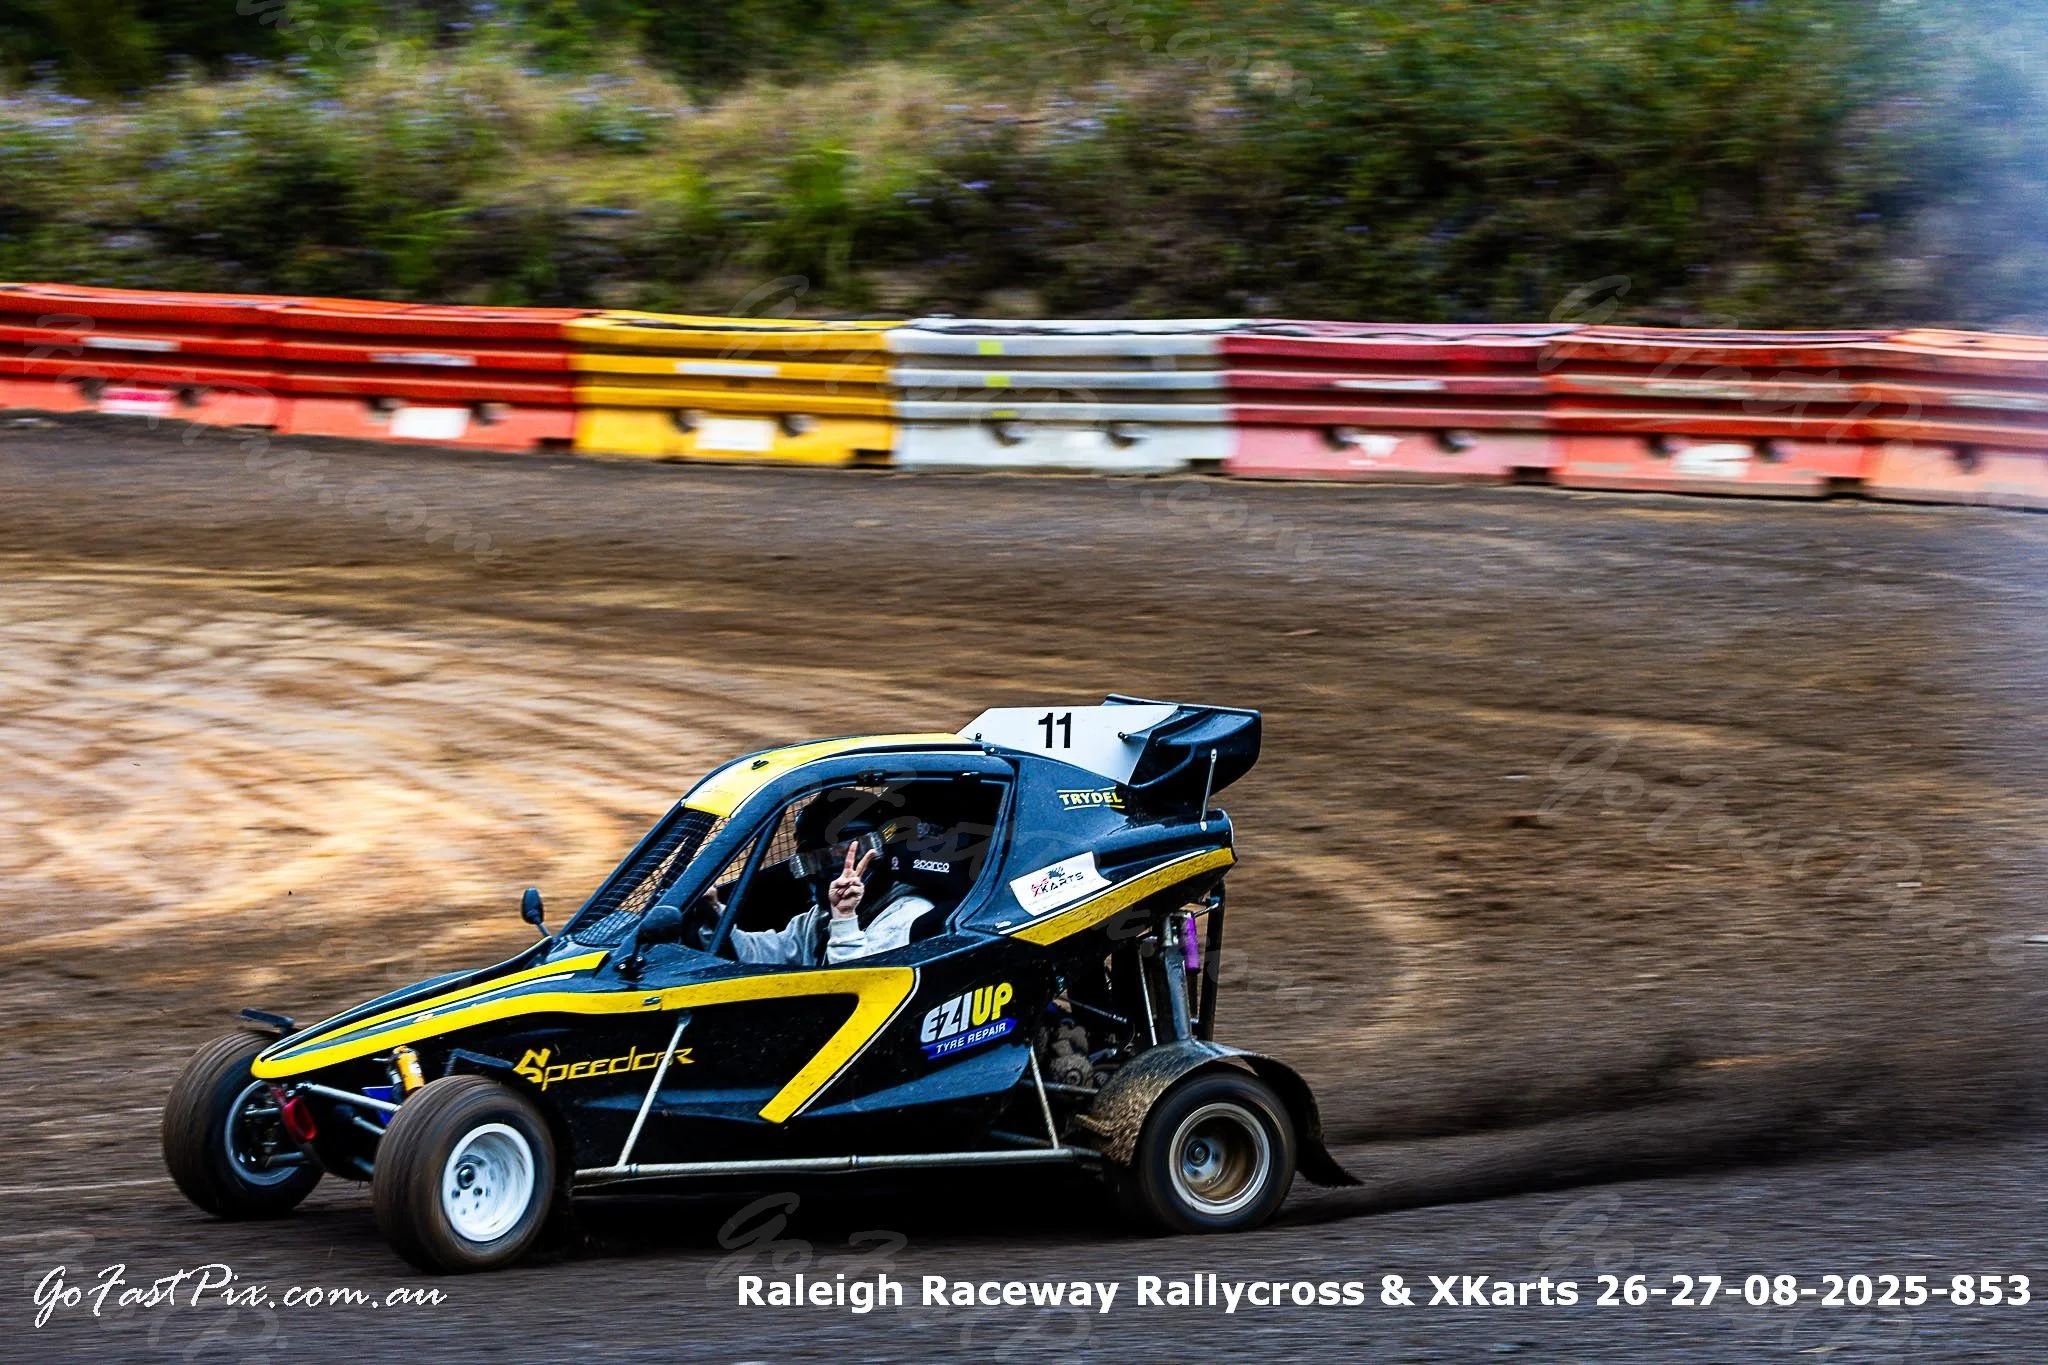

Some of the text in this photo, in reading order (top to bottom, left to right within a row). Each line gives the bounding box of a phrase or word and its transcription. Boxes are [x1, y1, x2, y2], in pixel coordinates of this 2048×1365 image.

[1038, 712, 1072, 749] 11
[1059, 792, 1123, 805] TRYDEL
[936, 1022, 1007, 1054] TYRE REPAIR
